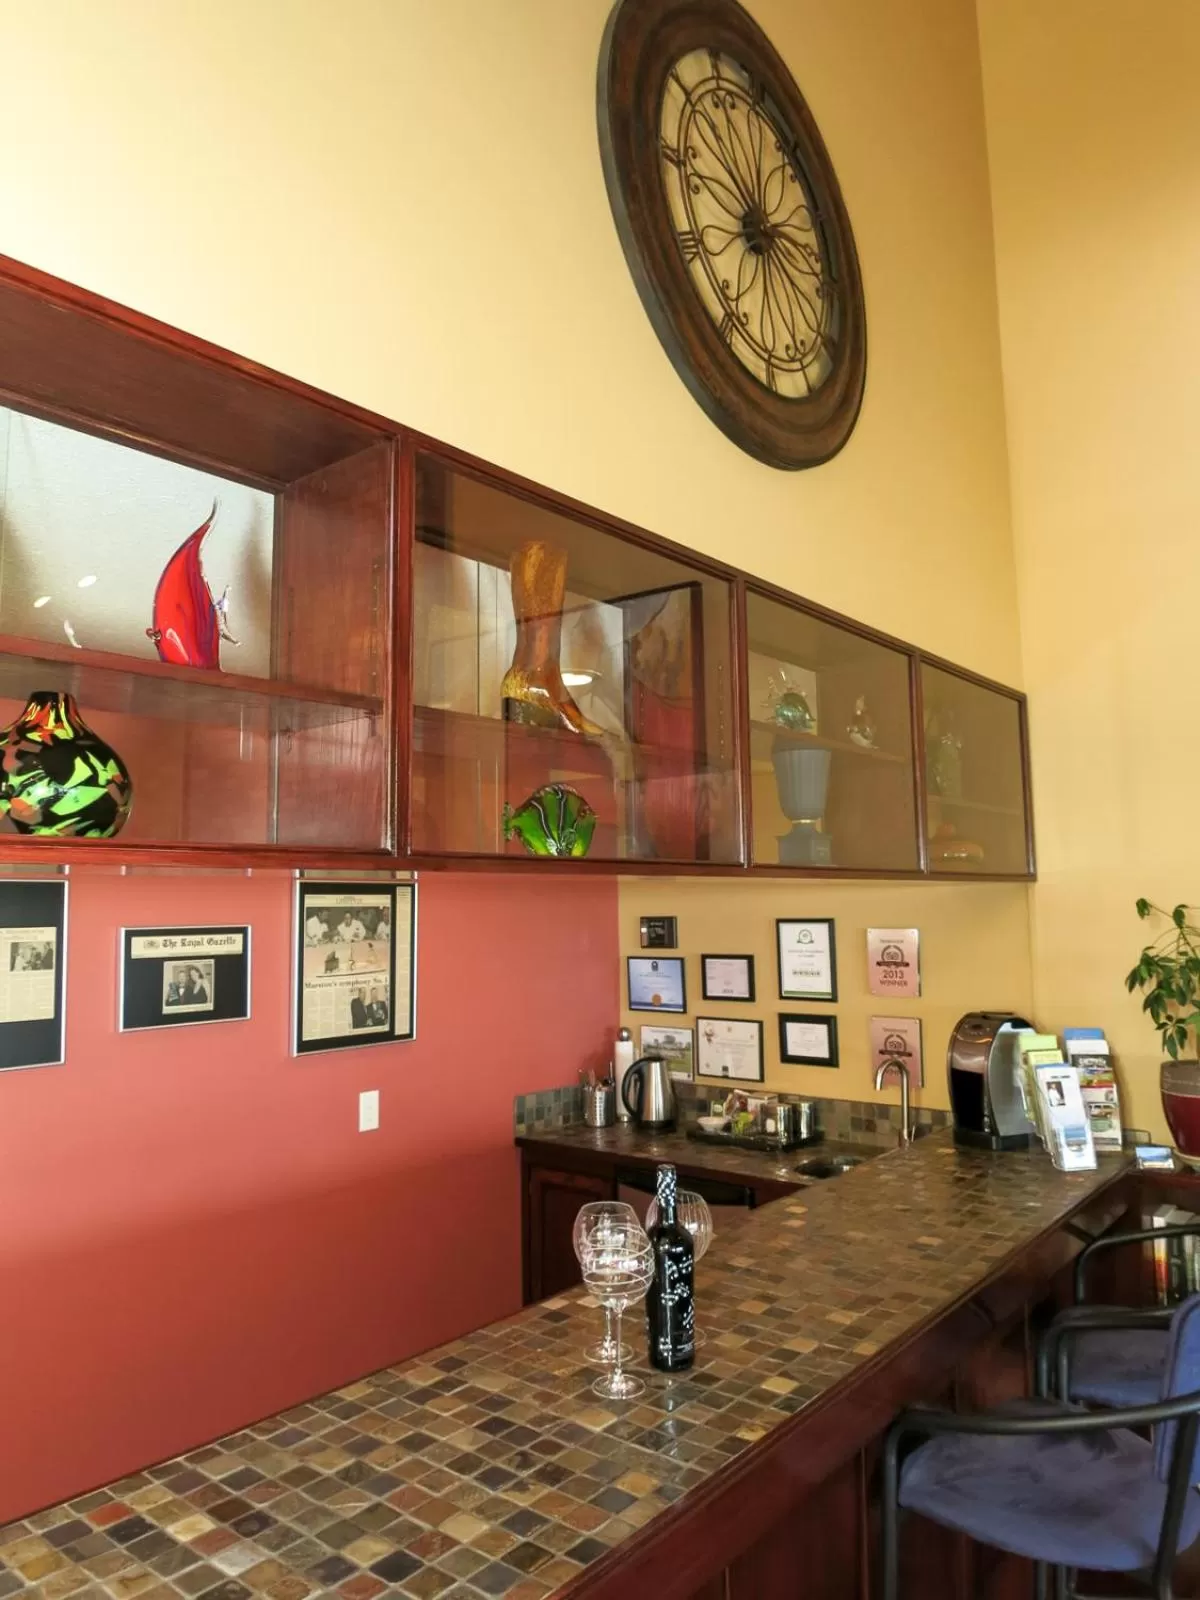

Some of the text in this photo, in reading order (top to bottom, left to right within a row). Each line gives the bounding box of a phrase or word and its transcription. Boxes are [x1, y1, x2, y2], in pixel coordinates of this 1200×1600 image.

[162, 936, 237, 948] The Royal Gazette
[882, 970, 904, 980] 2013
[879, 979, 908, 987] WINNER
